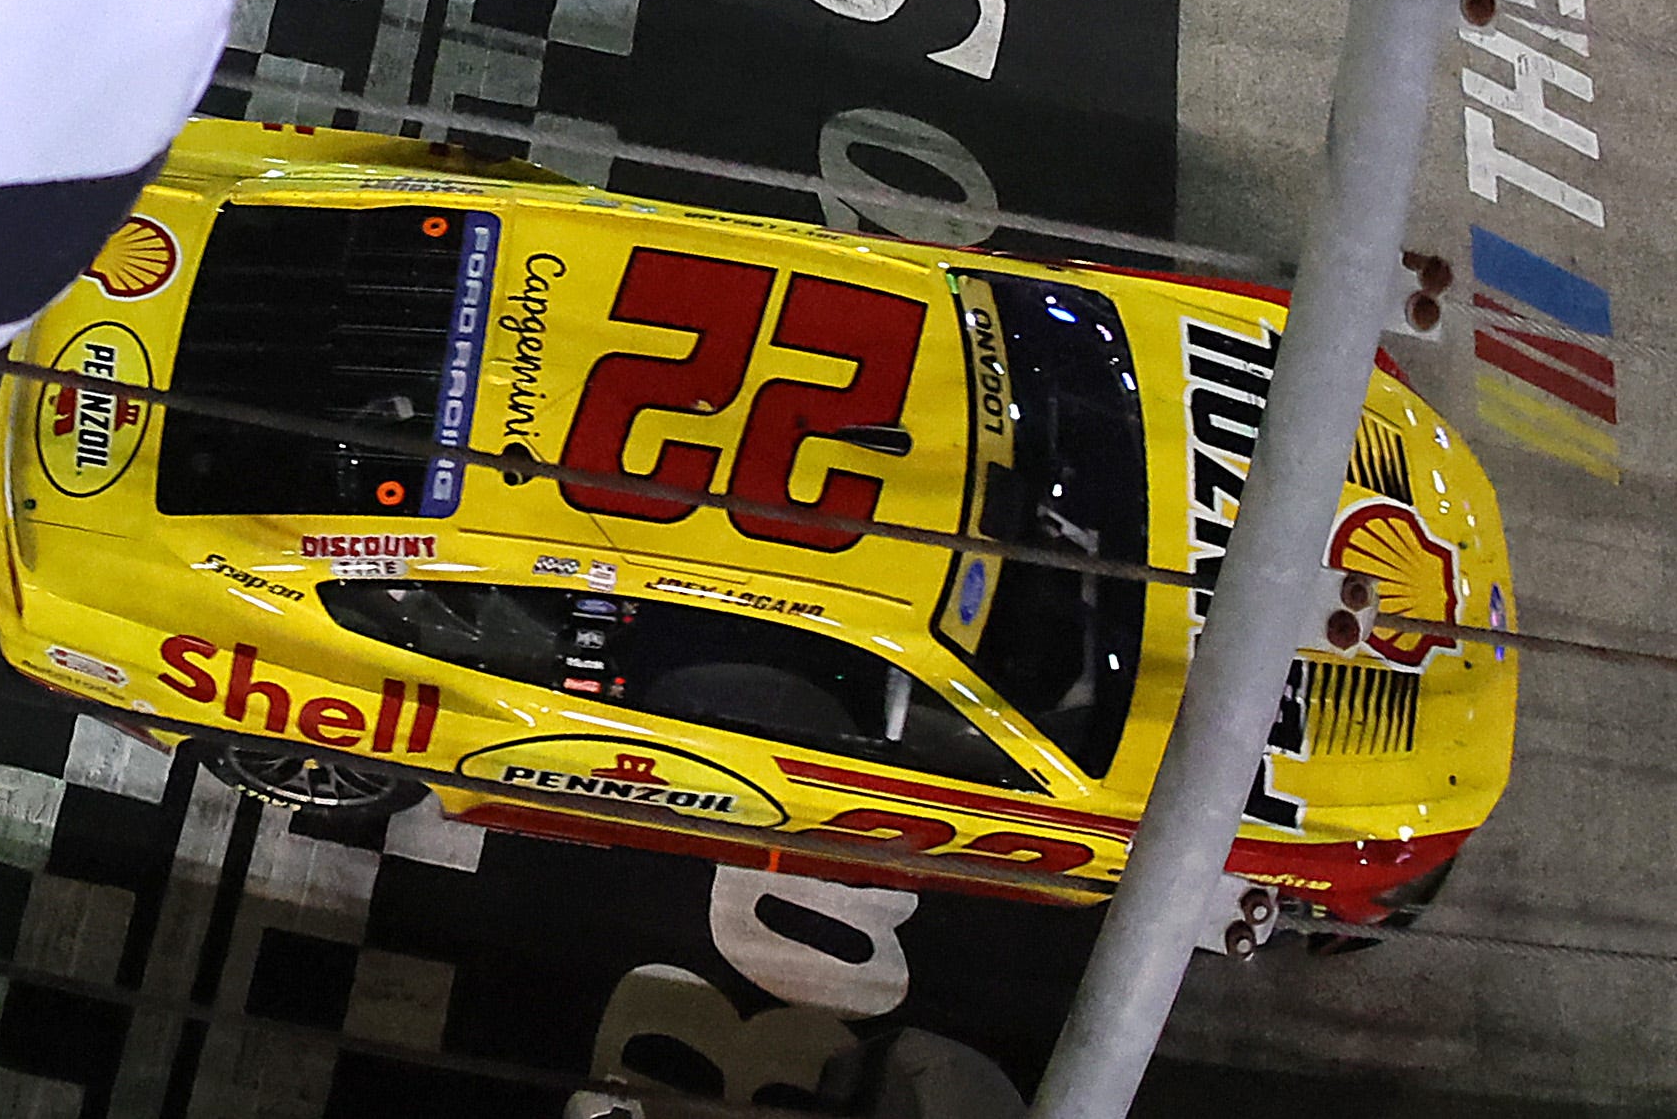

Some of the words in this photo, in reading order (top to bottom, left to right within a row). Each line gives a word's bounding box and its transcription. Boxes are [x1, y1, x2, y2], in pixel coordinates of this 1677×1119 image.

[458, 226, 491, 333] FORD
[75, 342, 115, 469] PENZOIL
[498, 252, 568, 438] Capgemini
[560, 245, 929, 554] 22
[972, 307, 1005, 436] LOGANO
[300, 535, 437, 559] DISCOUNT
[157, 633, 441, 754] Shell
[502, 764, 737, 814] PENNZOIL
